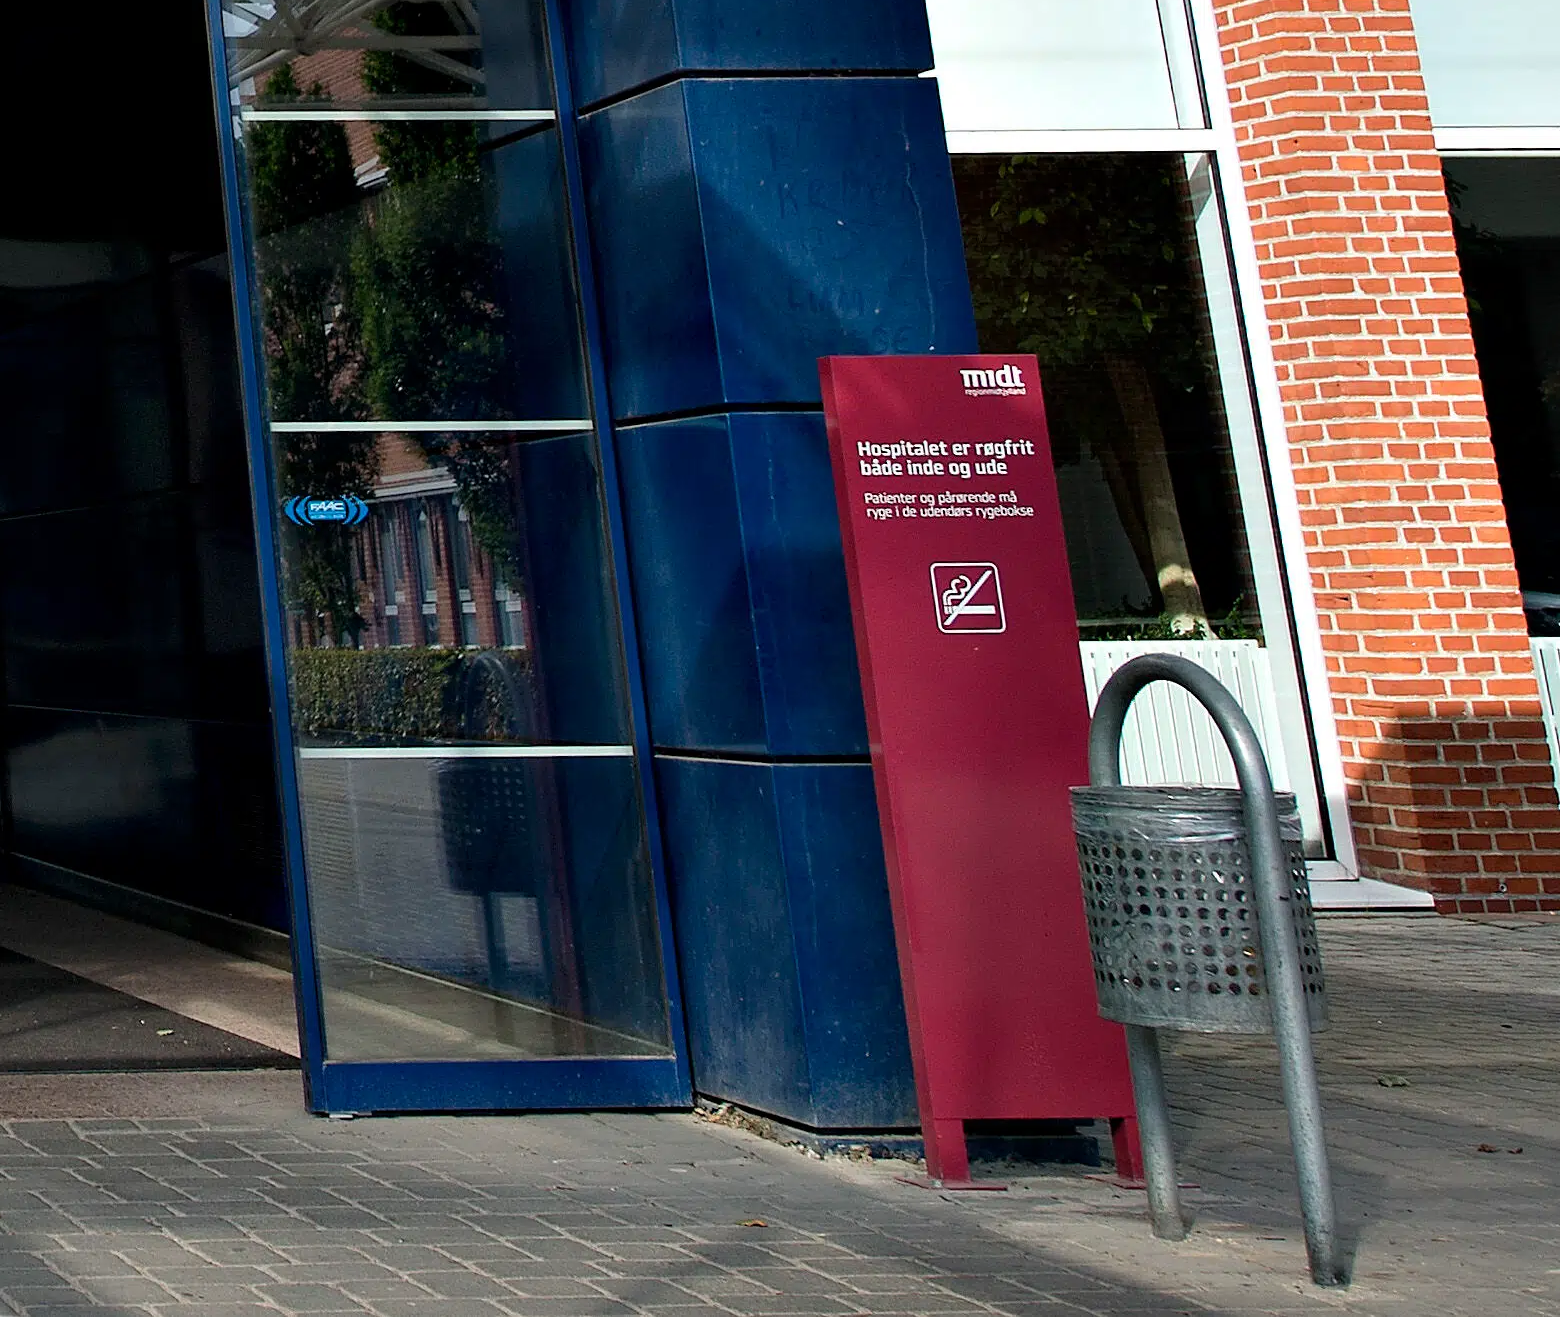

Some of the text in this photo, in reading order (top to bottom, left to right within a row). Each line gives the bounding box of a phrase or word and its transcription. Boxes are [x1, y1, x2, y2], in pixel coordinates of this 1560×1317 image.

[959, 364, 1026, 388] midt
[857, 439, 1035, 459] Hospitalet er røgfrit
[860, 458, 1008, 478] både inde og ude
[310, 501, 345, 512] FAAC
[864, 490, 1018, 506] Patienter og pårørende må
[866, 507, 893, 520] ryge
[902, 506, 917, 517] de
[920, 505, 973, 517] udendørs
[975, 505, 1034, 520] rygebokse
